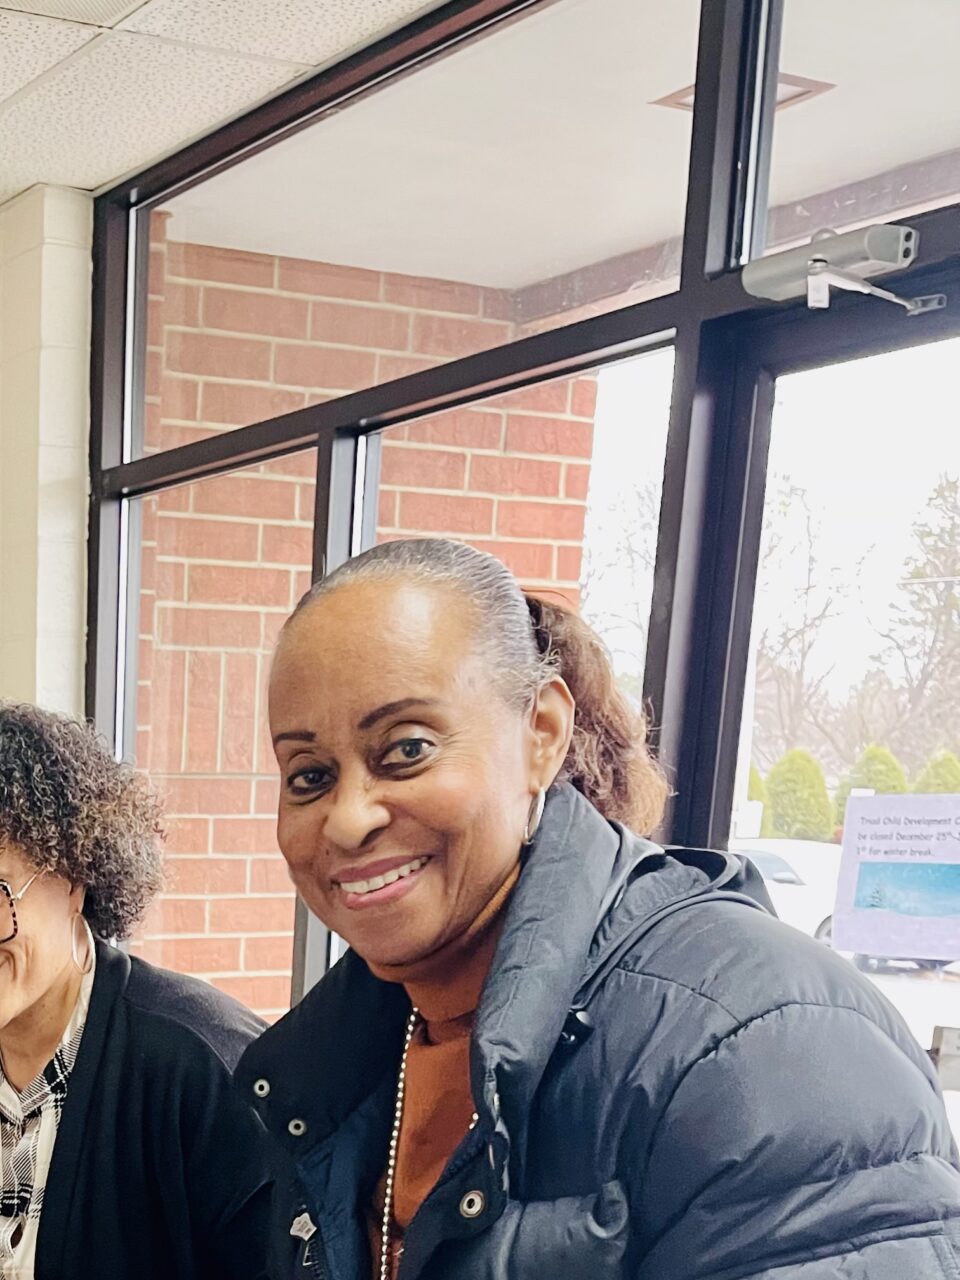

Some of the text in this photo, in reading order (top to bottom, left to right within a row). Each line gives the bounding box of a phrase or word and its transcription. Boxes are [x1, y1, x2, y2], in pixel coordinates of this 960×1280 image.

[860, 816, 880, 825] Triad
[883, 816, 901, 826] Child
[903, 816, 952, 827] Development
[870, 831, 894, 841] closed
[895, 831, 934, 841] December
[869, 846, 882, 856] for
[884, 848, 908, 856] winter
